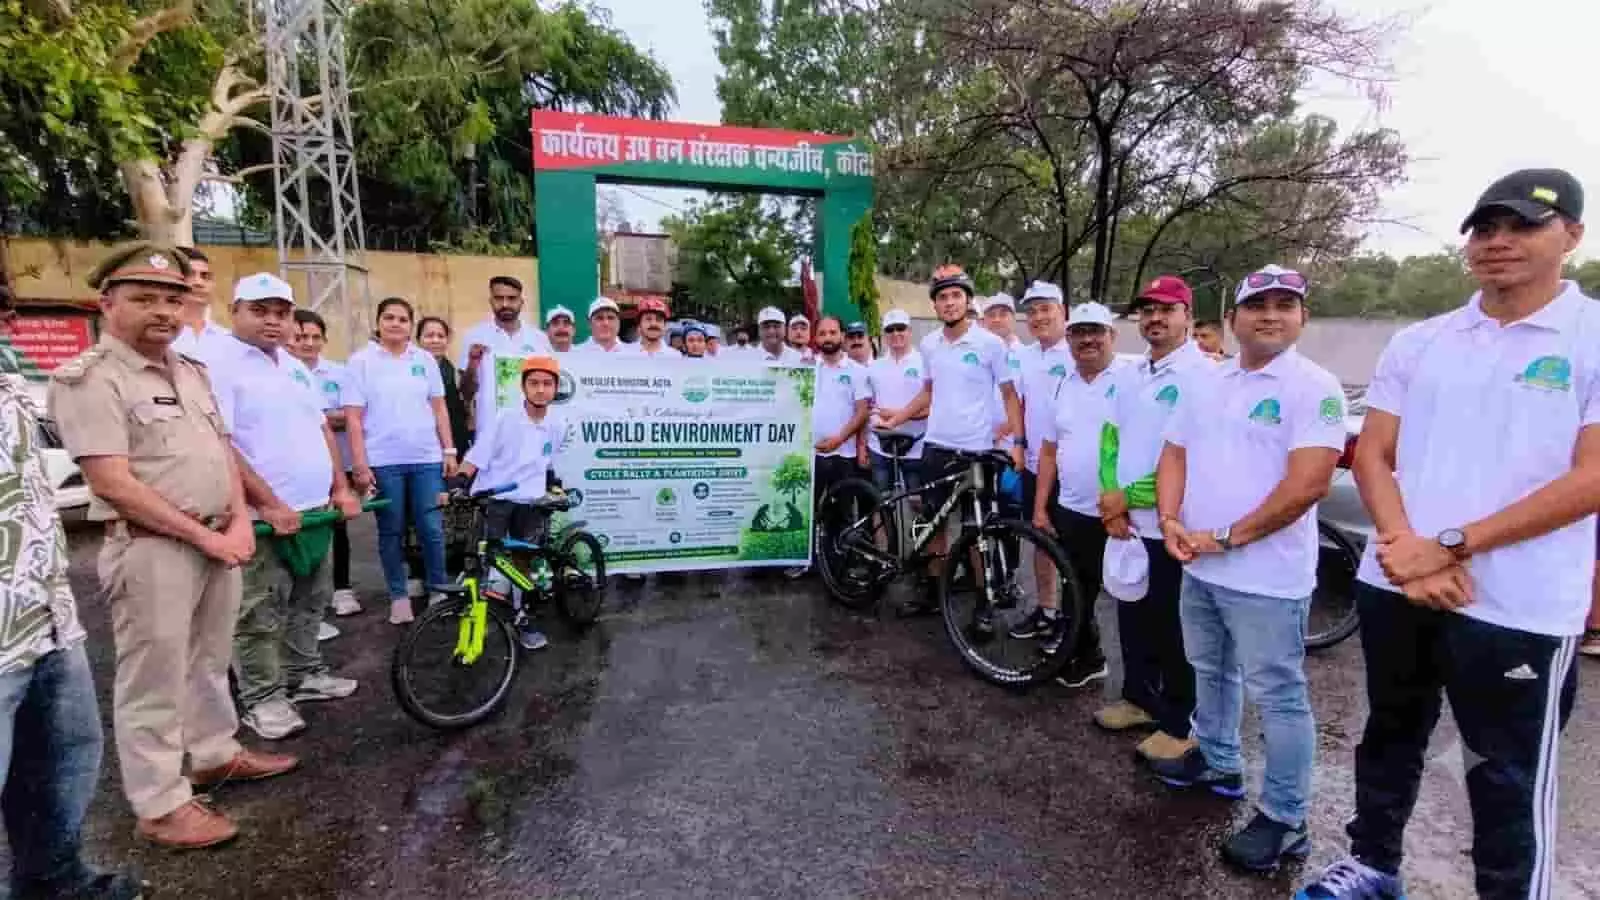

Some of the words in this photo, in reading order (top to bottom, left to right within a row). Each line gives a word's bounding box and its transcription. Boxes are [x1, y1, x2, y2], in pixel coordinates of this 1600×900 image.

[624, 135, 651, 162] उप
[654, 137, 684, 164] वन
[581, 421, 644, 443] WORLD
[650, 422, 763, 443] ENVIRONMENT
[768, 423, 796, 443] DAY
